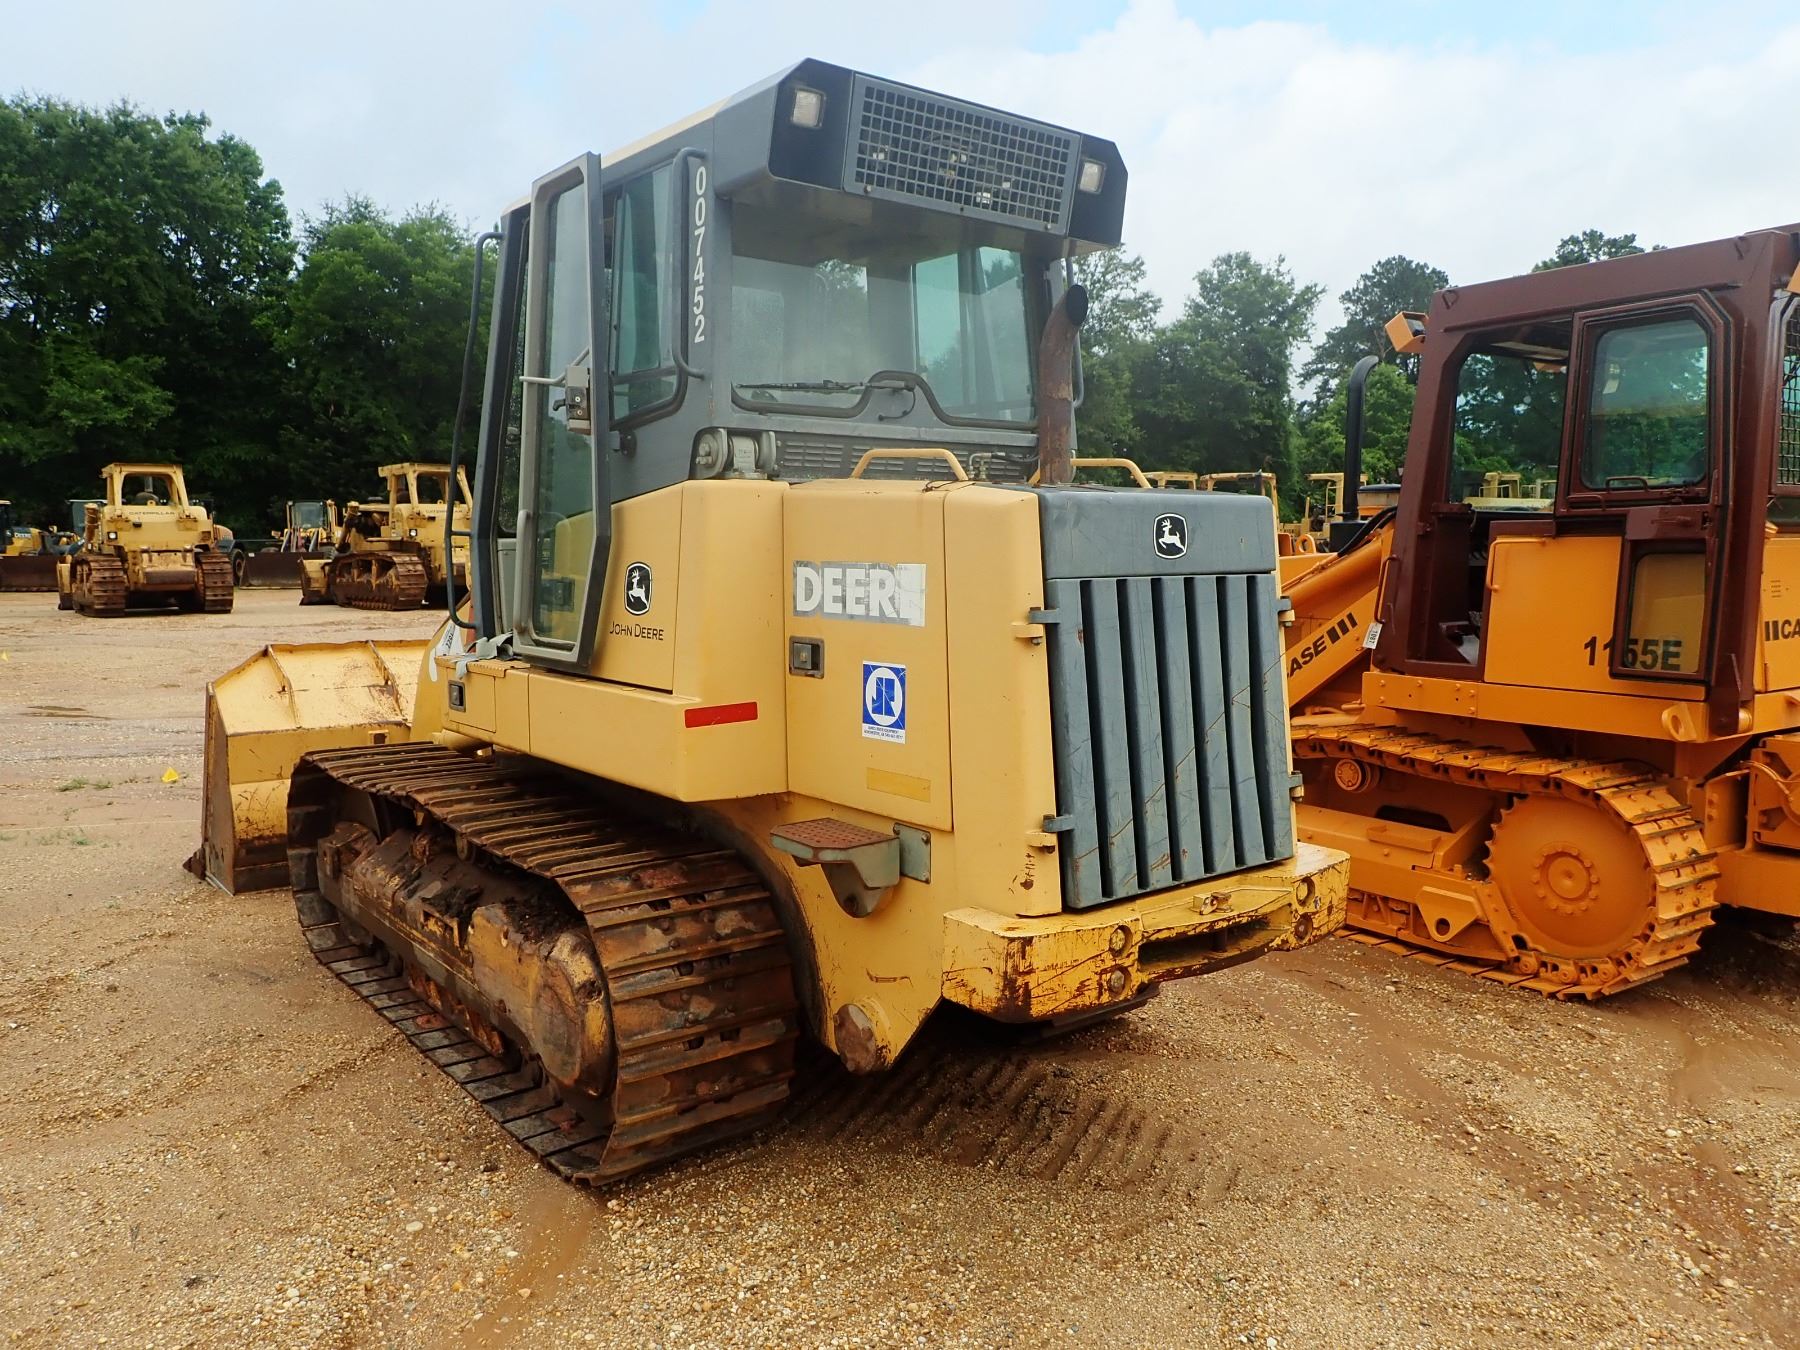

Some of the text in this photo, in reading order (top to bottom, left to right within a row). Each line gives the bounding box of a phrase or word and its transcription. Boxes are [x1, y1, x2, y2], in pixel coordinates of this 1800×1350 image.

[694, 166, 706, 344] 007452
[609, 620, 664, 641] JOHN DEERE
[1286, 634, 1328, 679] ASE
